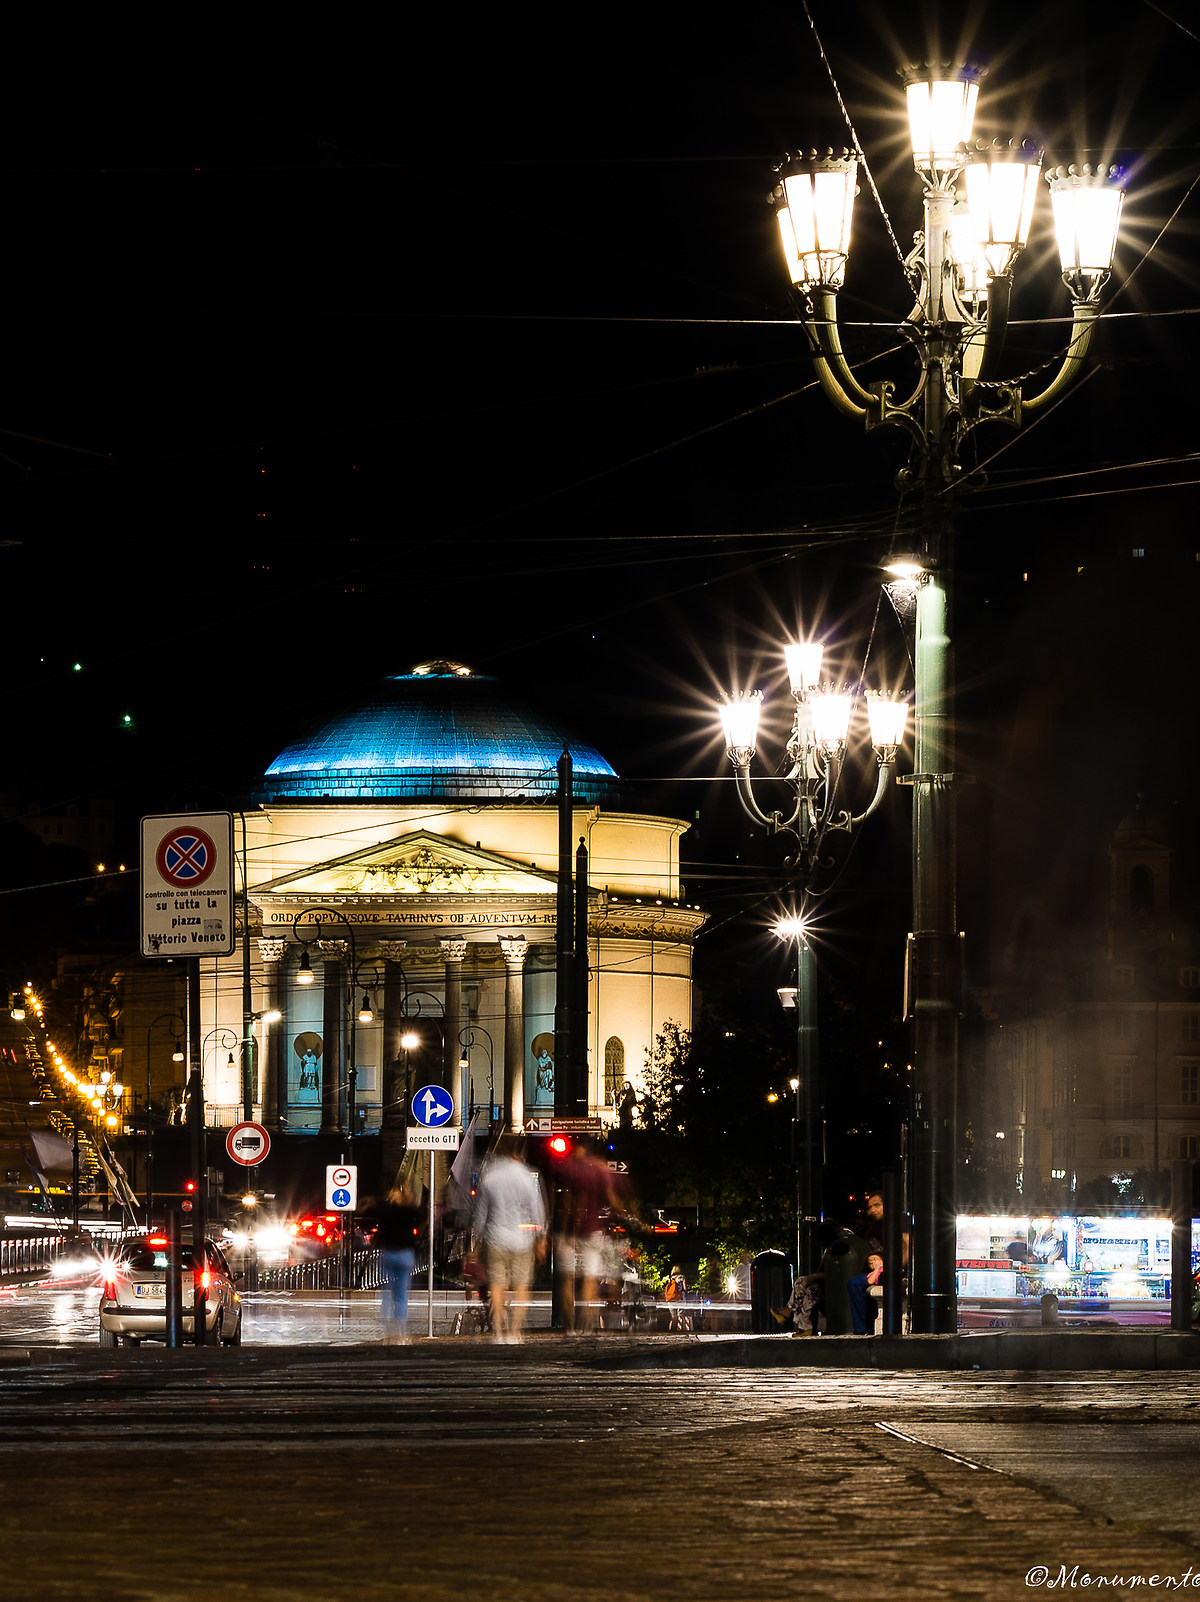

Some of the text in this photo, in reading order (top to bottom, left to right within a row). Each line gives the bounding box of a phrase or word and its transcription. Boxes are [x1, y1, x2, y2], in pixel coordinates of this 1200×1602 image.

[145, 890, 175, 898] controllo
[190, 889, 227, 897] telecamere
[156, 898, 217, 910] su tutta la
[172, 915, 201, 928] piazza
[270, 913, 301, 922] ORDO
[386, 913, 444, 922] TAVRINVS
[450, 913, 464, 922] OB
[470, 914, 536, 923] ADVENTVM
[409, 1134, 456, 1143] eccetto GTT
